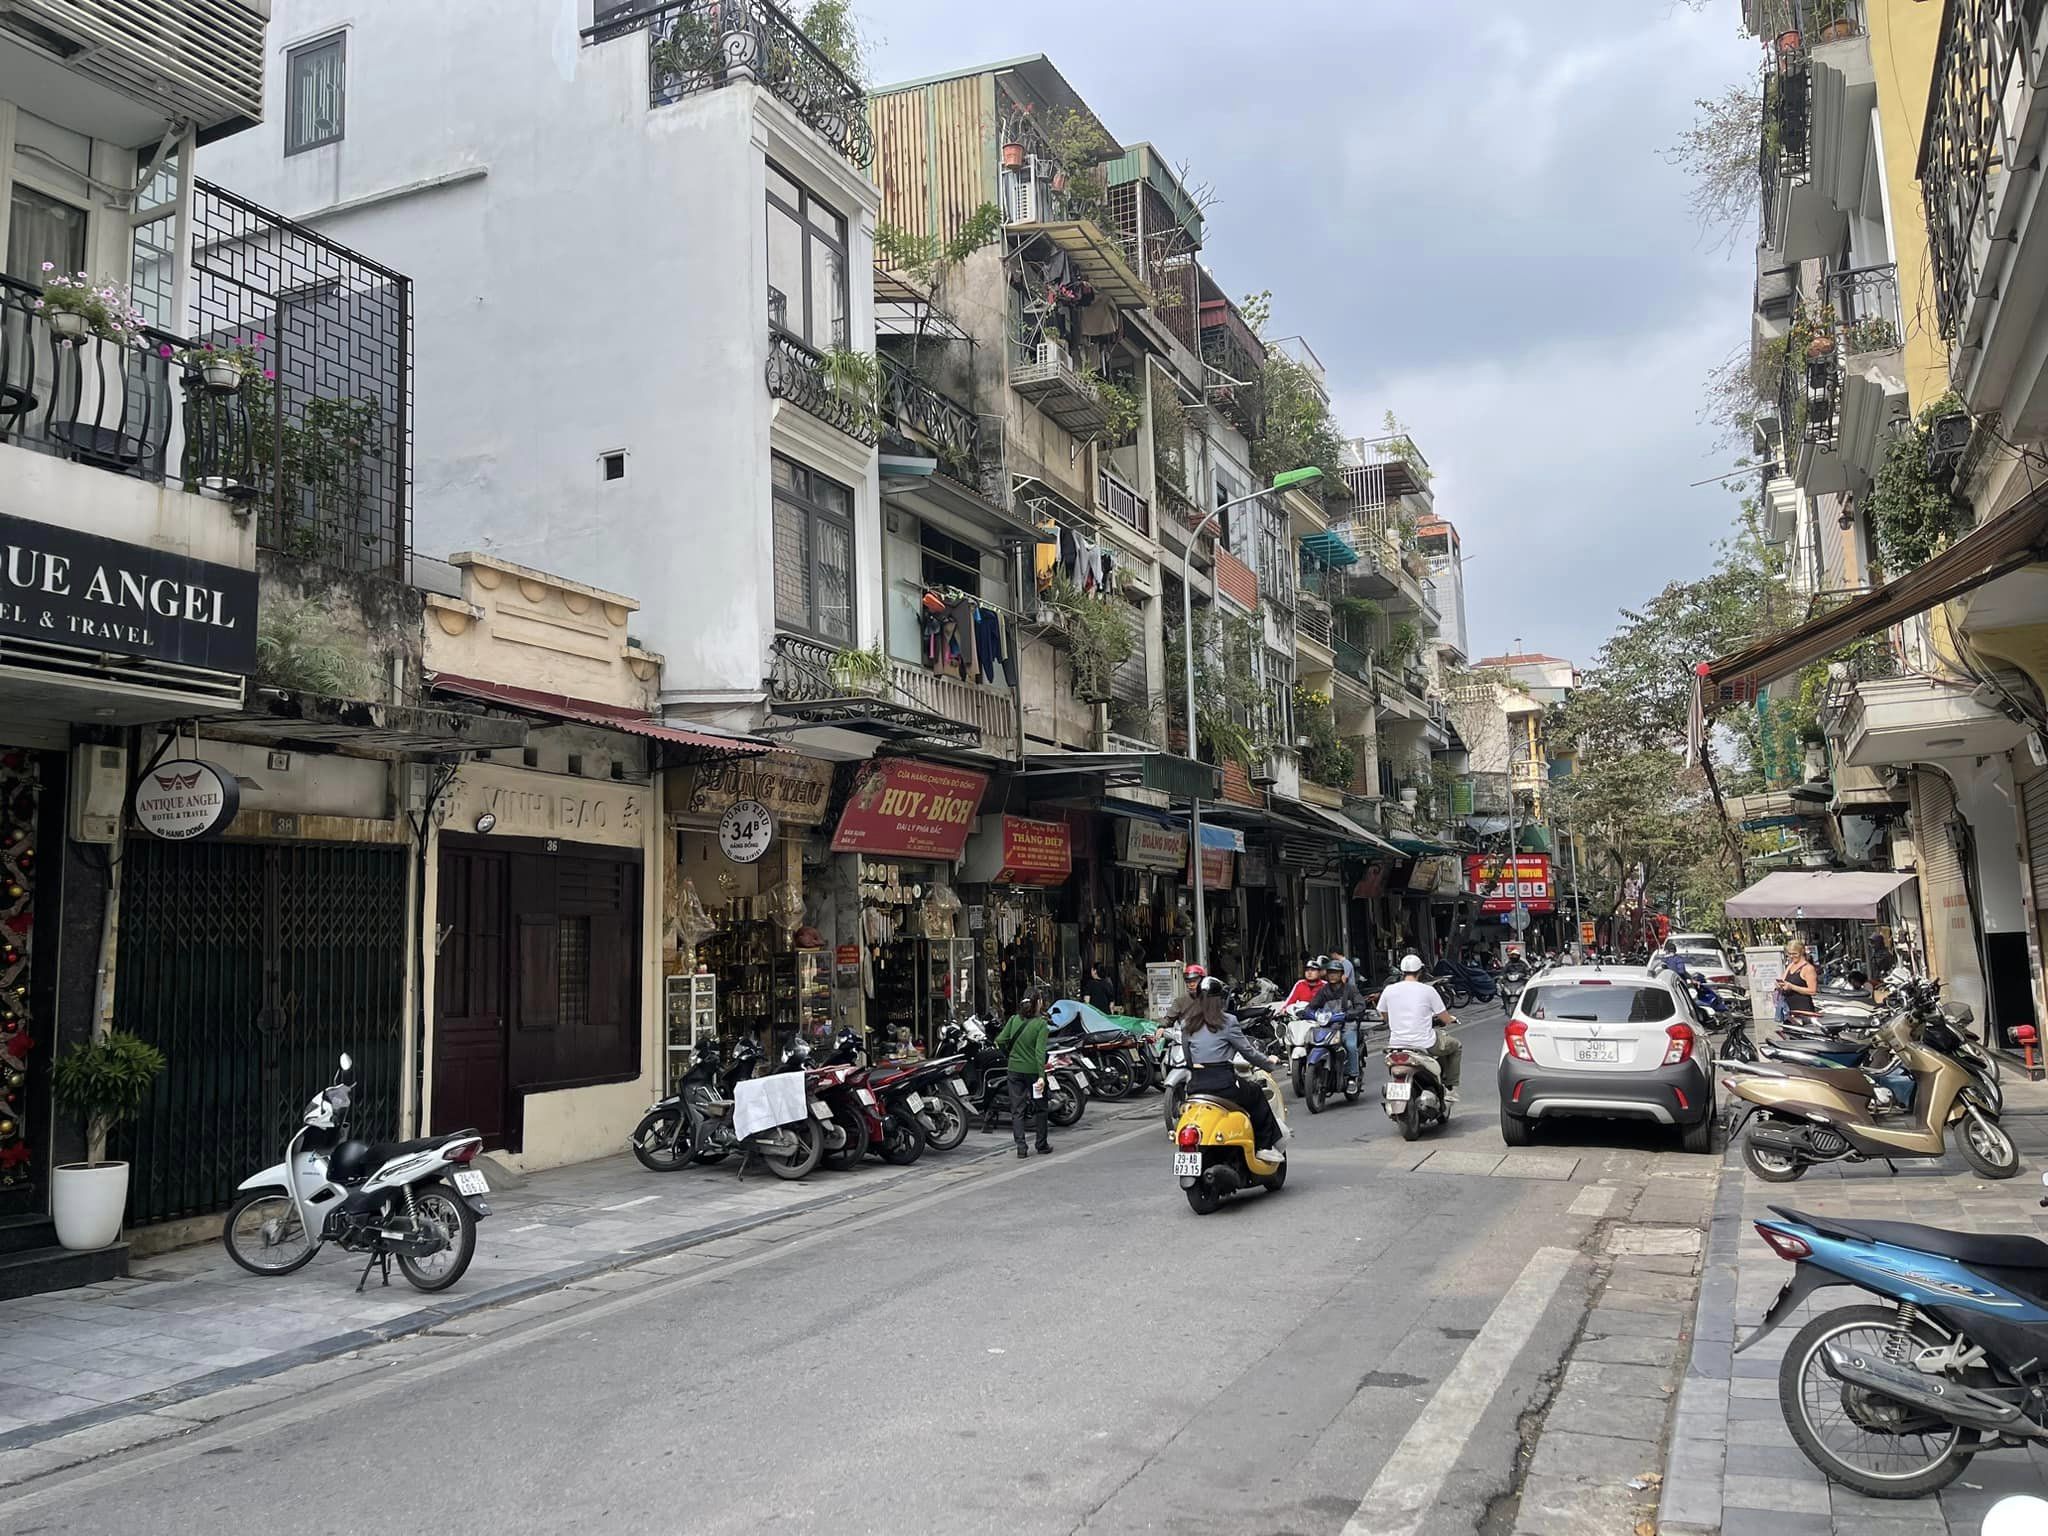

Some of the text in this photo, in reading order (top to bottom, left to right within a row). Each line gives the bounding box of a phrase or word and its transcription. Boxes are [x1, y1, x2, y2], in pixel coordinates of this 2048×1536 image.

[0, 545, 236, 628] UE ANGEL
[39, 611, 54, 629] &
[67, 615, 154, 646] TRAVEL
[139, 793, 221, 812] ANTIQUE ANGEL
[779, 779, 825, 806] THU
[152, 813, 174, 821] HOTEL
[183, 810, 208, 819] TRAVEL
[722, 803, 769, 829] DUNG THU
[878, 788, 974, 825] HUY BÍCH
[166, 829, 185, 838] HANG
[186, 822, 205, 836] DONG
[278, 818, 293, 833] 38
[547, 840, 557, 851] 36
